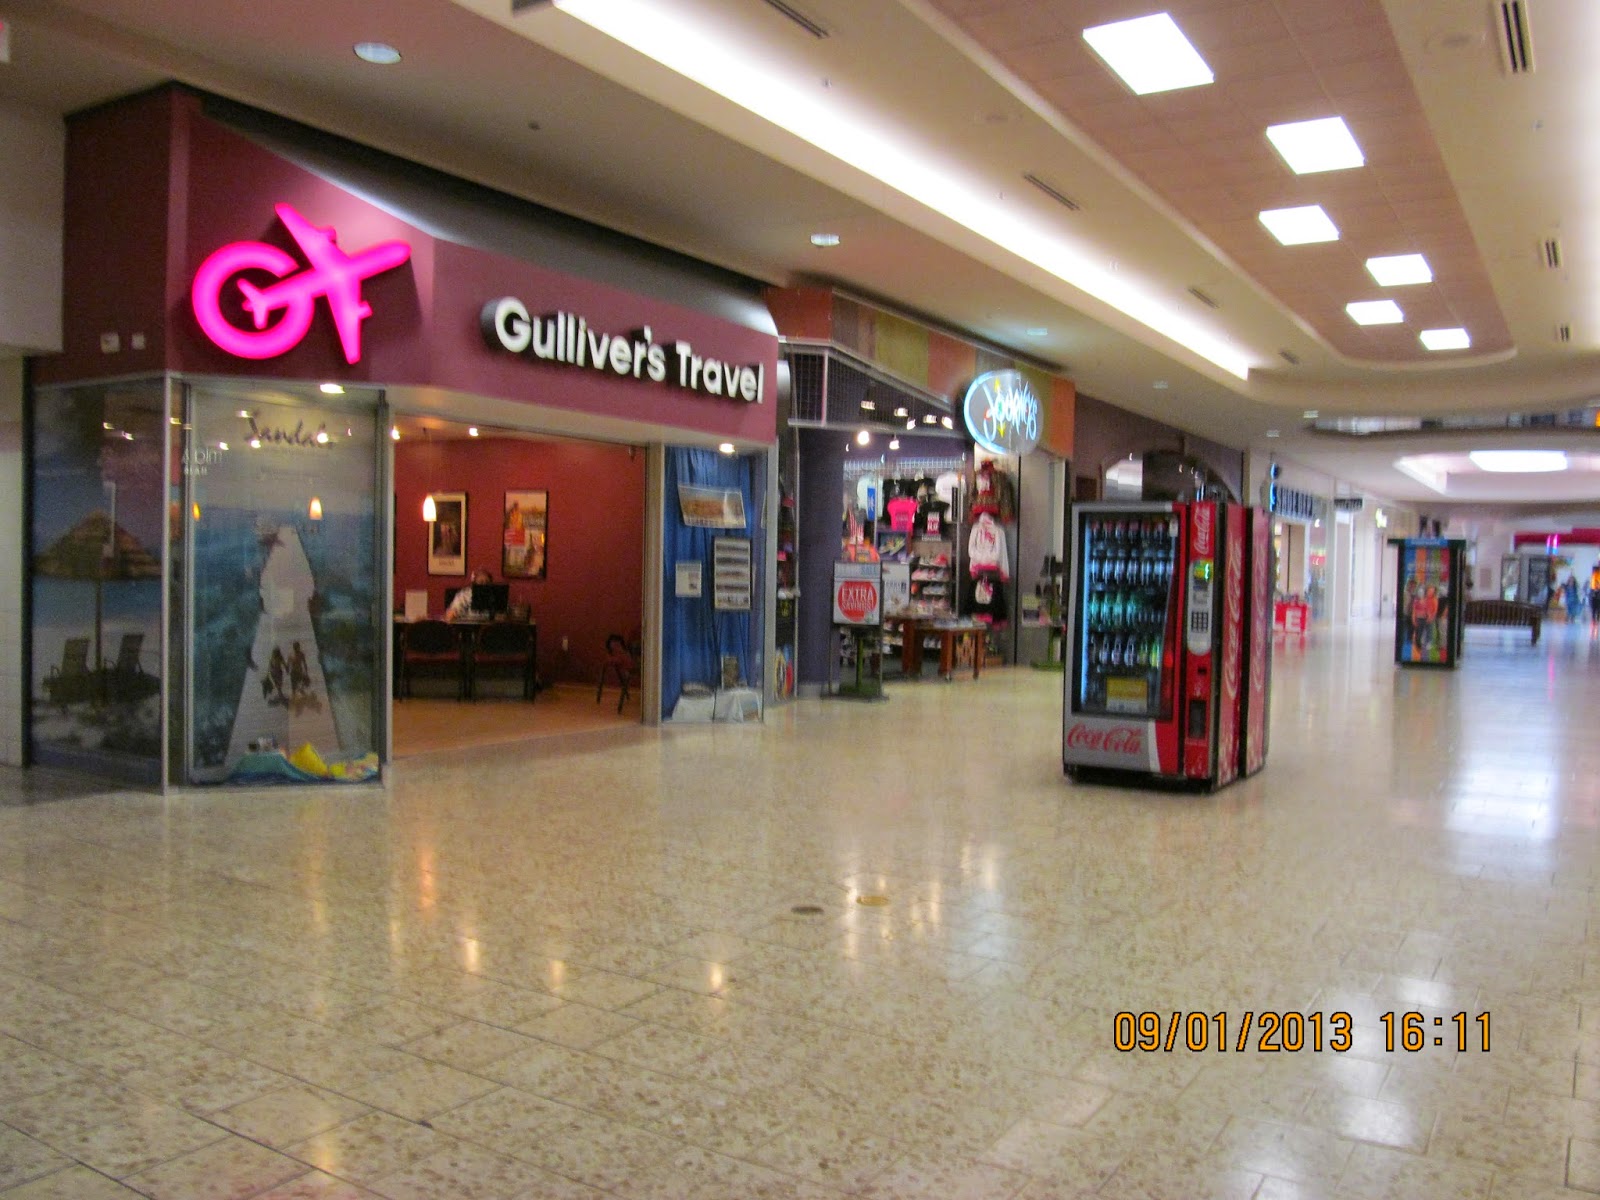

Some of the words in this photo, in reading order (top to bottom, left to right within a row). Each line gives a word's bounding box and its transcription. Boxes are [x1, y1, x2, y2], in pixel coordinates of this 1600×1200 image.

[494, 296, 666, 382] Gulliver's
[676, 340, 764, 404] Travel
[841, 586, 874, 602] EXTRA
